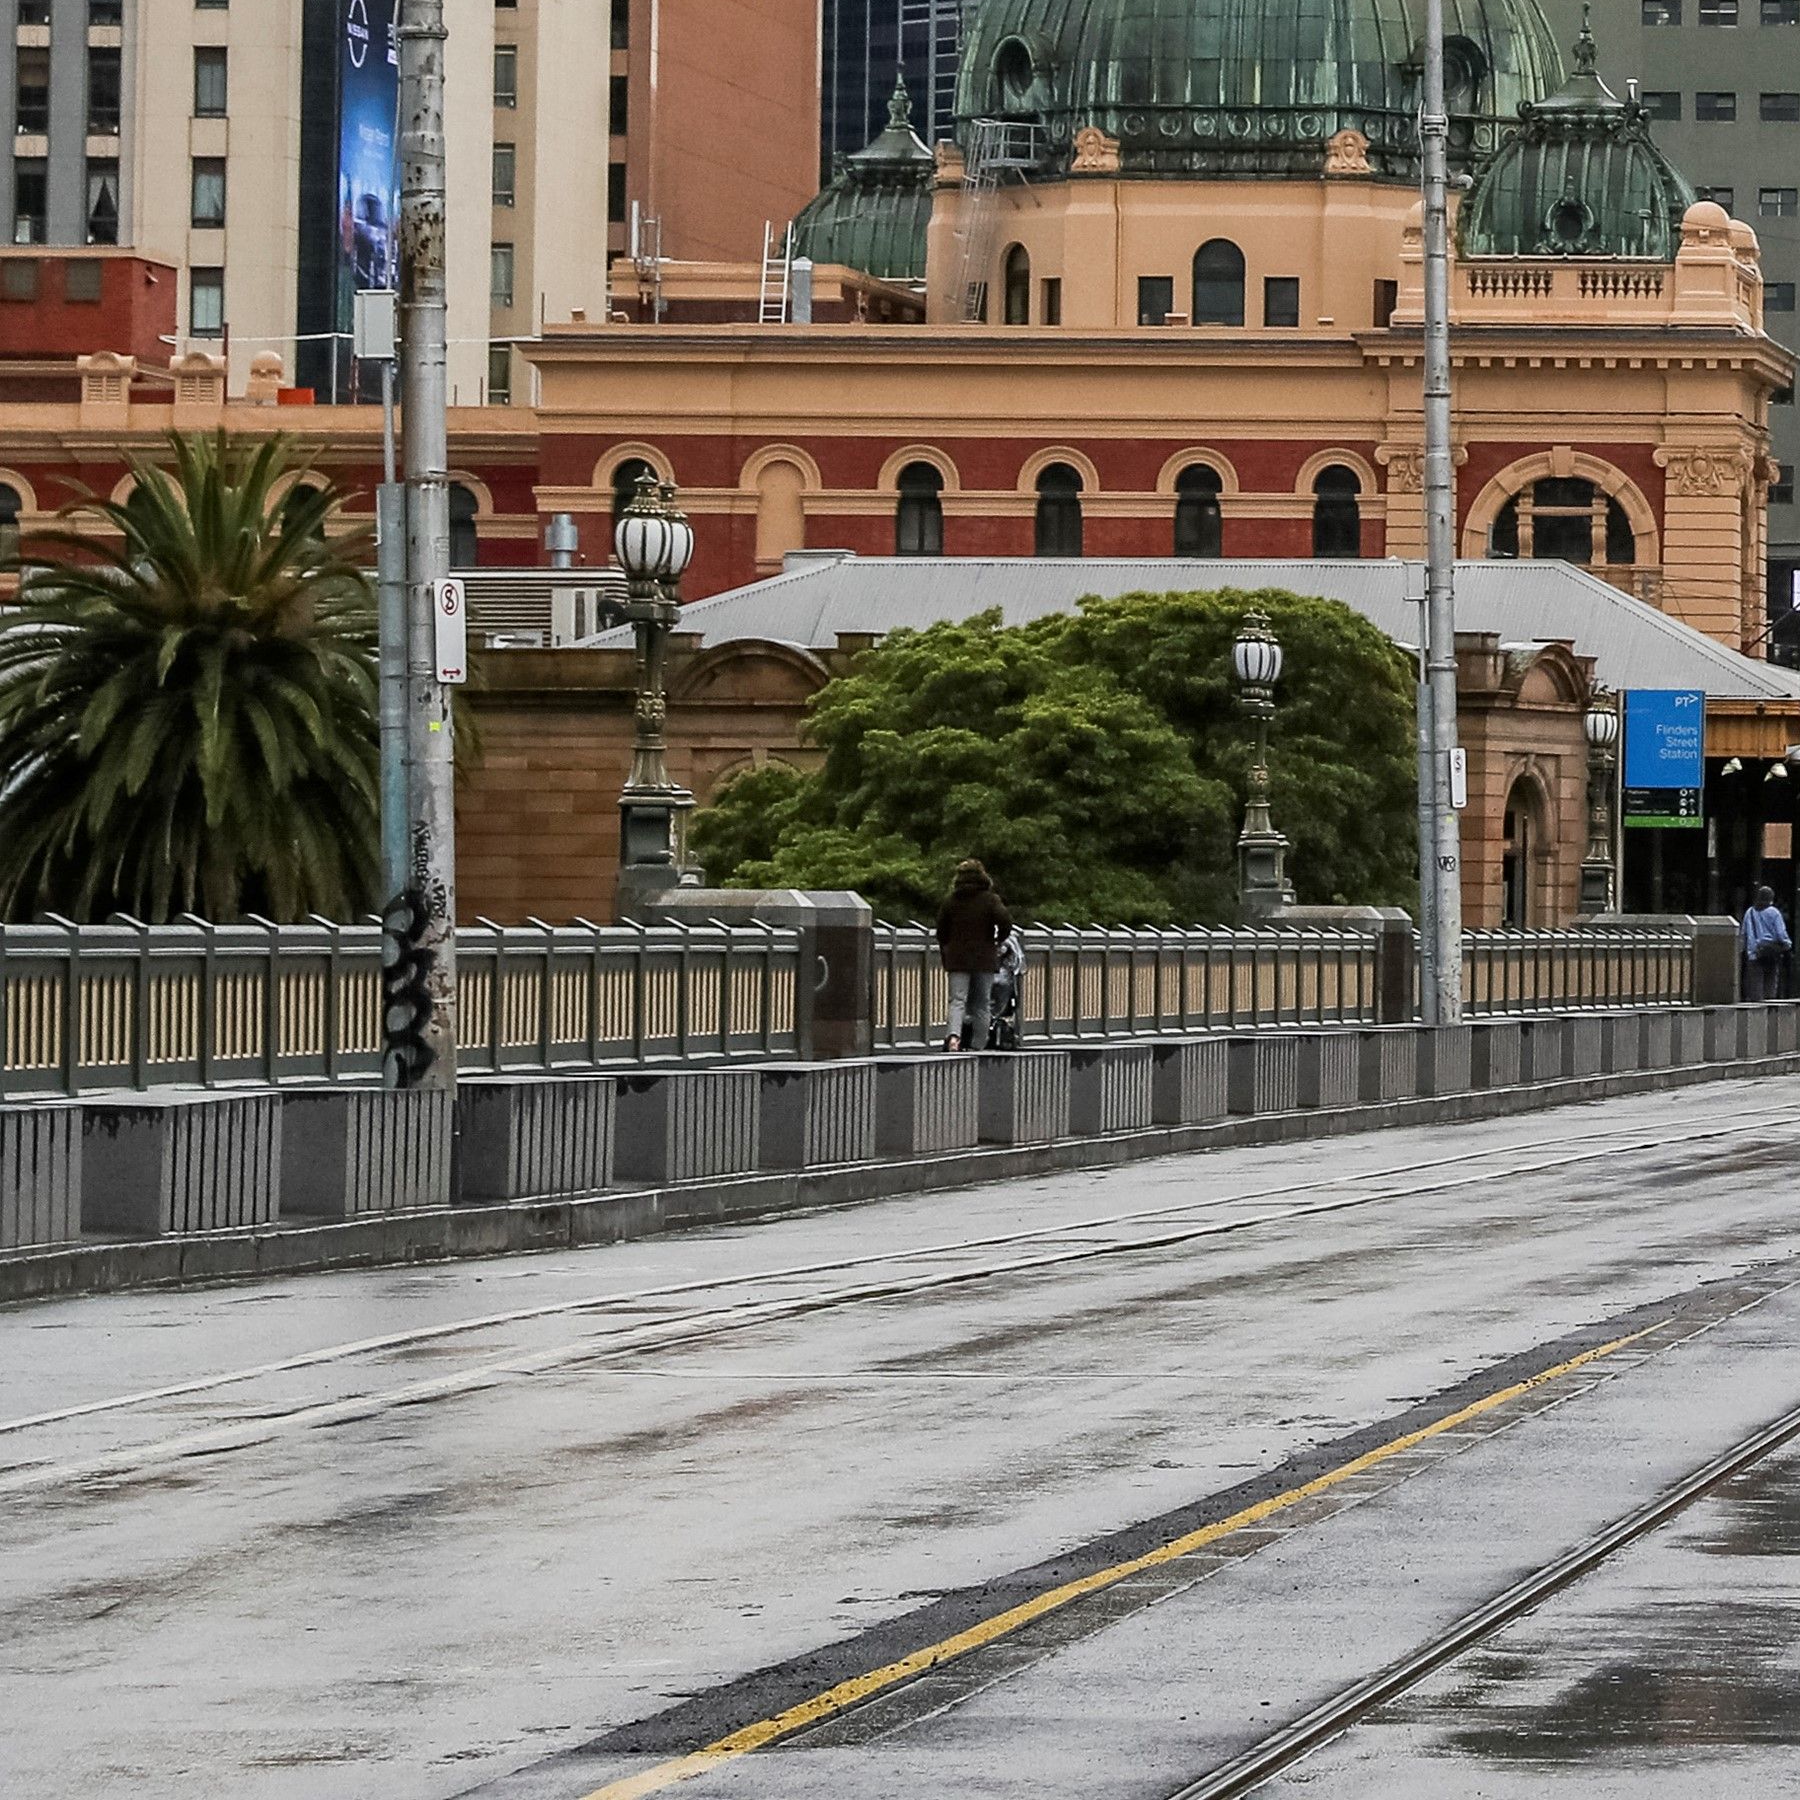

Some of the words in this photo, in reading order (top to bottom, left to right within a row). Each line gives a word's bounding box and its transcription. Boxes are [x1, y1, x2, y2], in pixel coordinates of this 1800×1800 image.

[1656, 724, 1698, 735] Flinders
[1665, 736, 1698, 747] Street
[1659, 748, 1698, 759] Station
